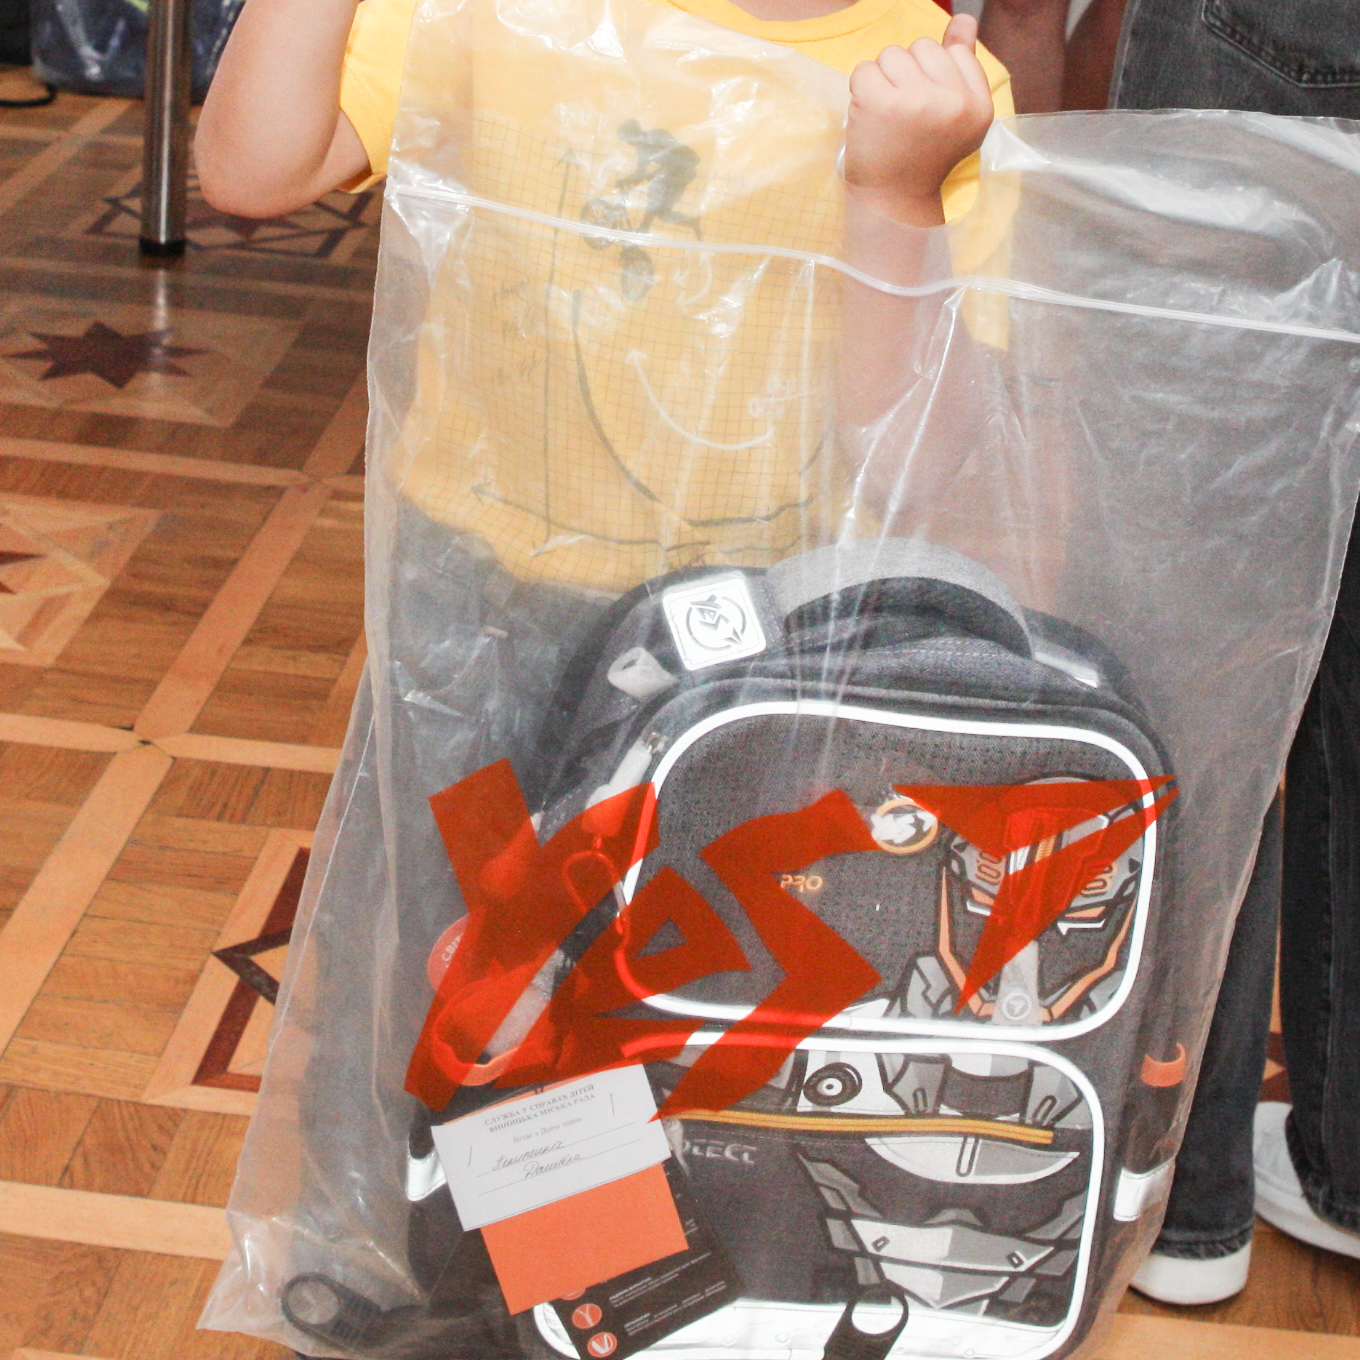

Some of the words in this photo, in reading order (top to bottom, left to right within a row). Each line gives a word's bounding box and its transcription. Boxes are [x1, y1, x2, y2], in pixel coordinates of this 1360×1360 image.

[484, 1110, 521, 1127] СЛУЖБА
[529, 1093, 569, 1112] СПРАВАХ
[539, 1101, 573, 1117] МІСЬКА
[573, 1093, 596, 1106] РАДА
